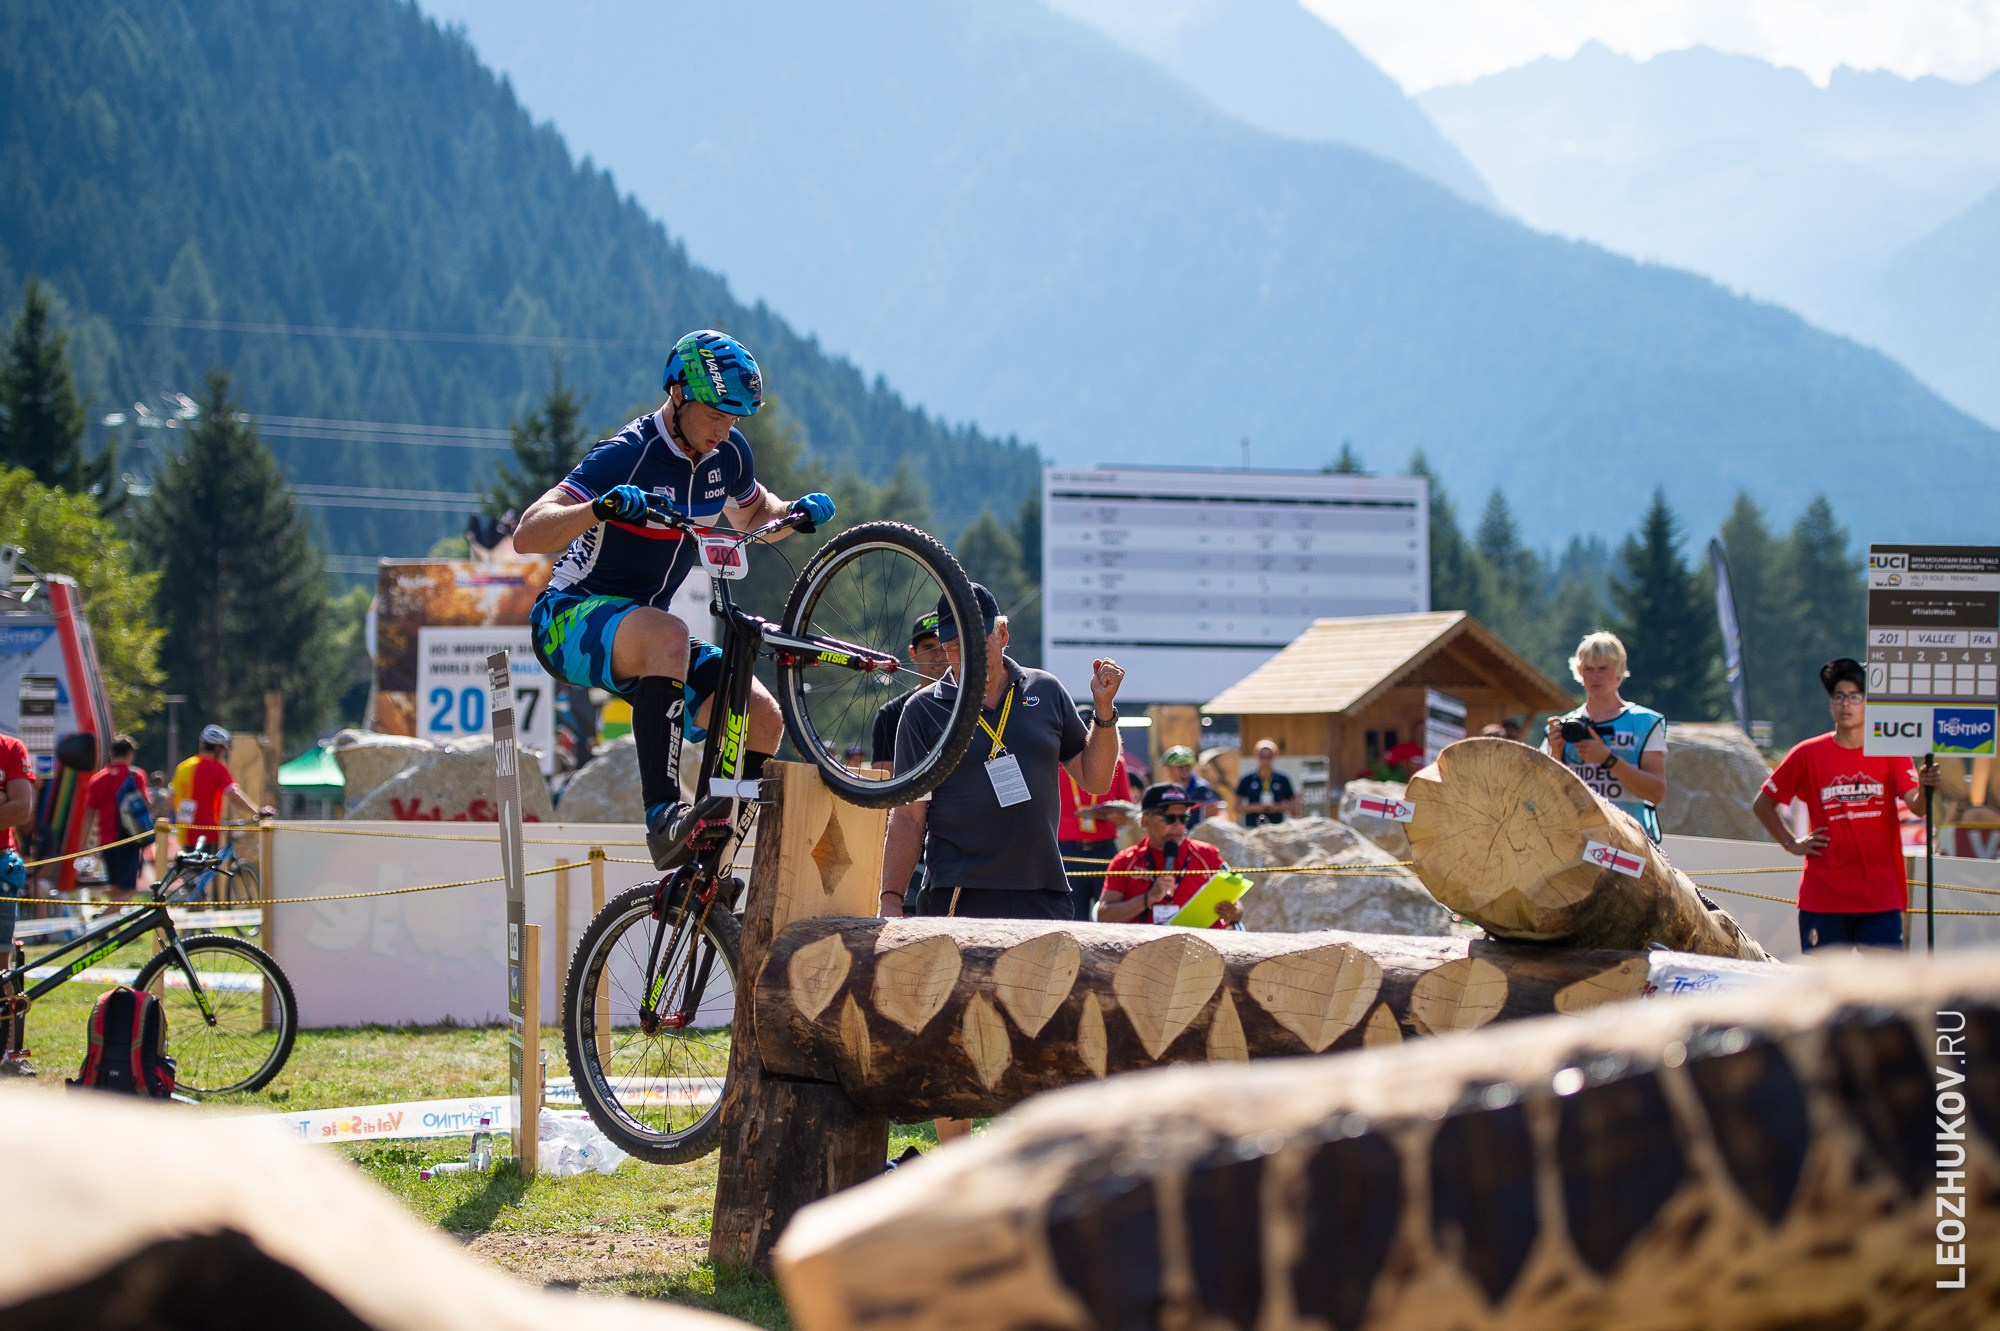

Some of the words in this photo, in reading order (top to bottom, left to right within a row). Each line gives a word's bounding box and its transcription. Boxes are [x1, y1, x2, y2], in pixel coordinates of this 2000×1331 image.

[706, 359, 728, 396] VARIAL
[705, 487, 725, 499] LOOK
[711, 547, 737, 566] 201
[1876, 556, 1906, 568] UCI
[1912, 608, 1956, 616] #TrialsWorlds
[1878, 633, 1899, 644] 201
[1918, 634, 1957, 644] VALLEE
[1973, 635, 1992, 644] FRA
[1871, 652, 1885, 660] HC
[1897, 652, 1902, 661] 1
[1917, 652, 1925, 662] 2
[1940, 652, 1948, 662] 3
[1961, 652, 1970, 662] 4
[1984, 653, 1992, 662] 5
[1883, 722, 1922, 738] UCI
[1937, 718, 1991, 736] TRENTINO
[495, 738, 514, 777] START
[1821, 783, 1884, 801] BIKELAND
